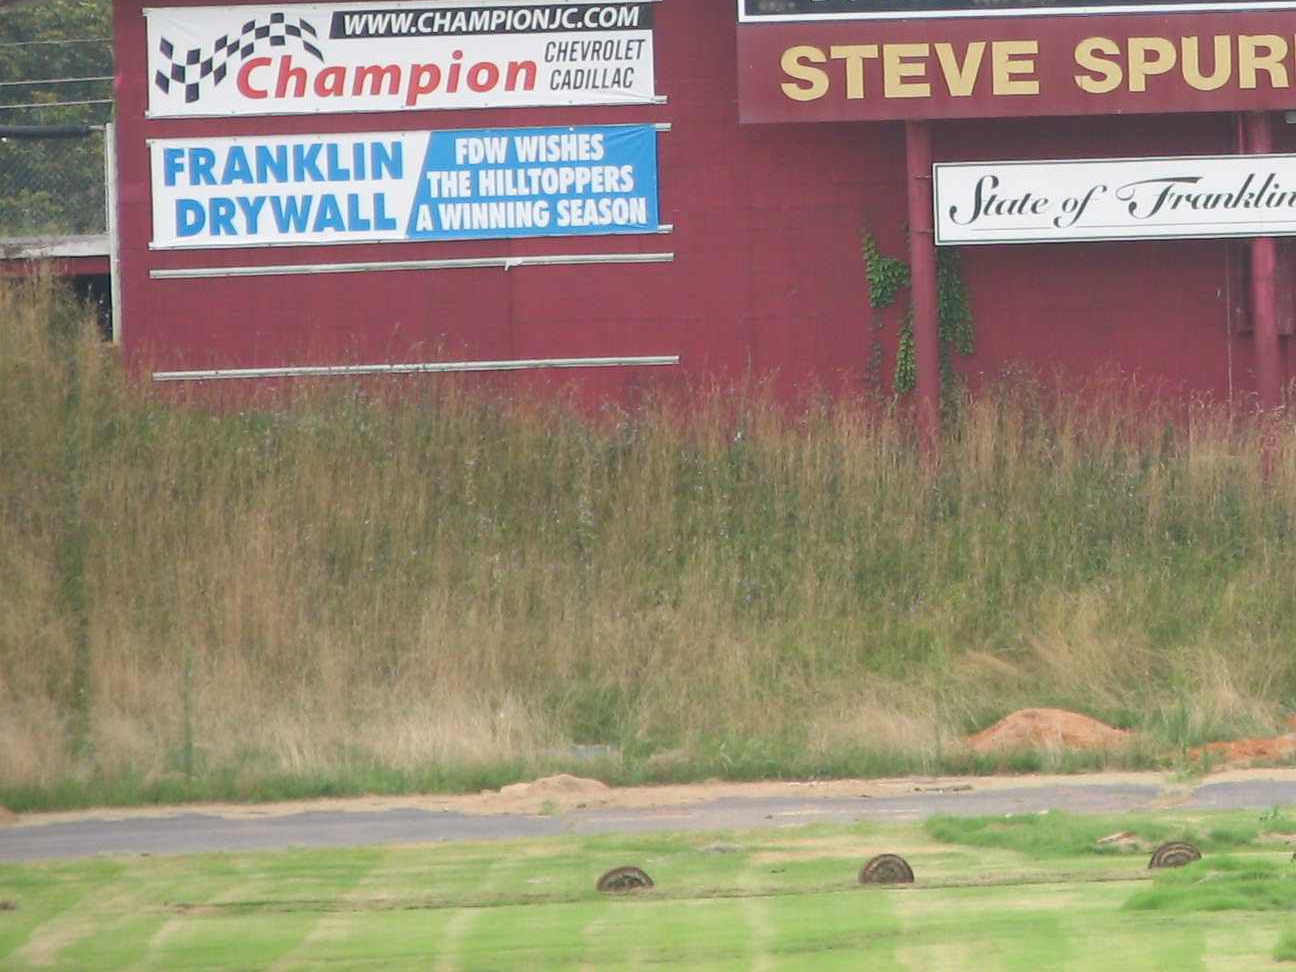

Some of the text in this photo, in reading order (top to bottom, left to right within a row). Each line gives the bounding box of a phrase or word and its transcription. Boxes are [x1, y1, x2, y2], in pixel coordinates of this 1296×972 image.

[343, 5, 640, 36] WWW.CHAMPIONJC.COM
[543, 38, 645, 63] CHEVROLET
[236, 49, 538, 106] Champion
[549, 67, 634, 90] CADILLAC
[780, 40, 1041, 101] STEVE
[163, 141, 402, 187] FRANKLIN
[455, 133, 604, 165] FDW WISHES
[426, 165, 634, 198] THE HILLTOPPERS
[176, 191, 397, 236] DRYWALL
[415, 196, 646, 232] A WINNING SEASON
[950, 175, 1048, 225] State
[1053, 185, 1107, 228] of
